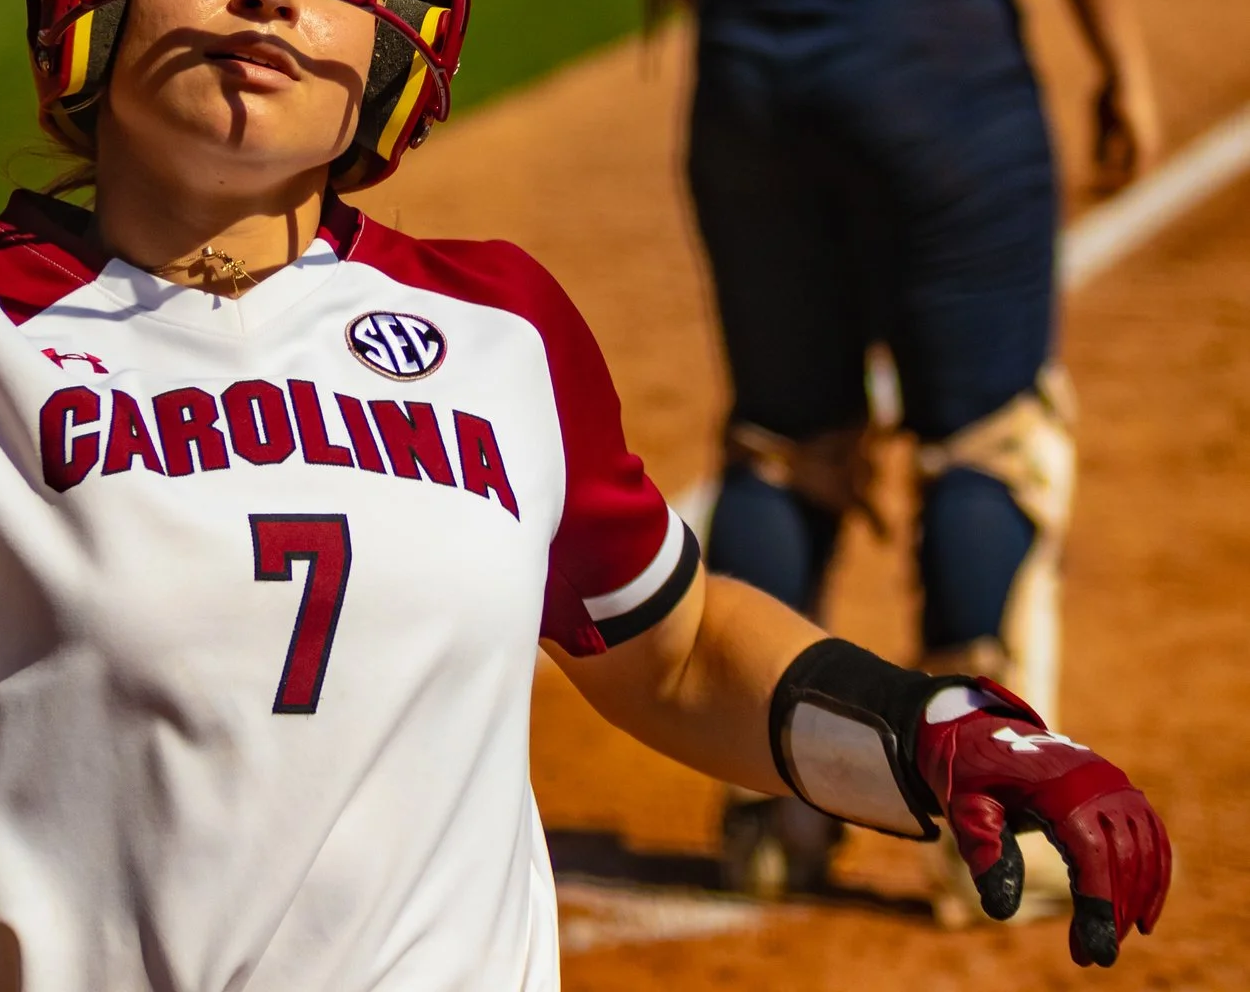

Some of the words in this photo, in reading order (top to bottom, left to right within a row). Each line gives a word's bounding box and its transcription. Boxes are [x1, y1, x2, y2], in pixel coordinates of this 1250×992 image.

[353, 313, 440, 374] SEC
[39, 378, 520, 523] CAROLINA
[248, 513, 352, 715] 7
